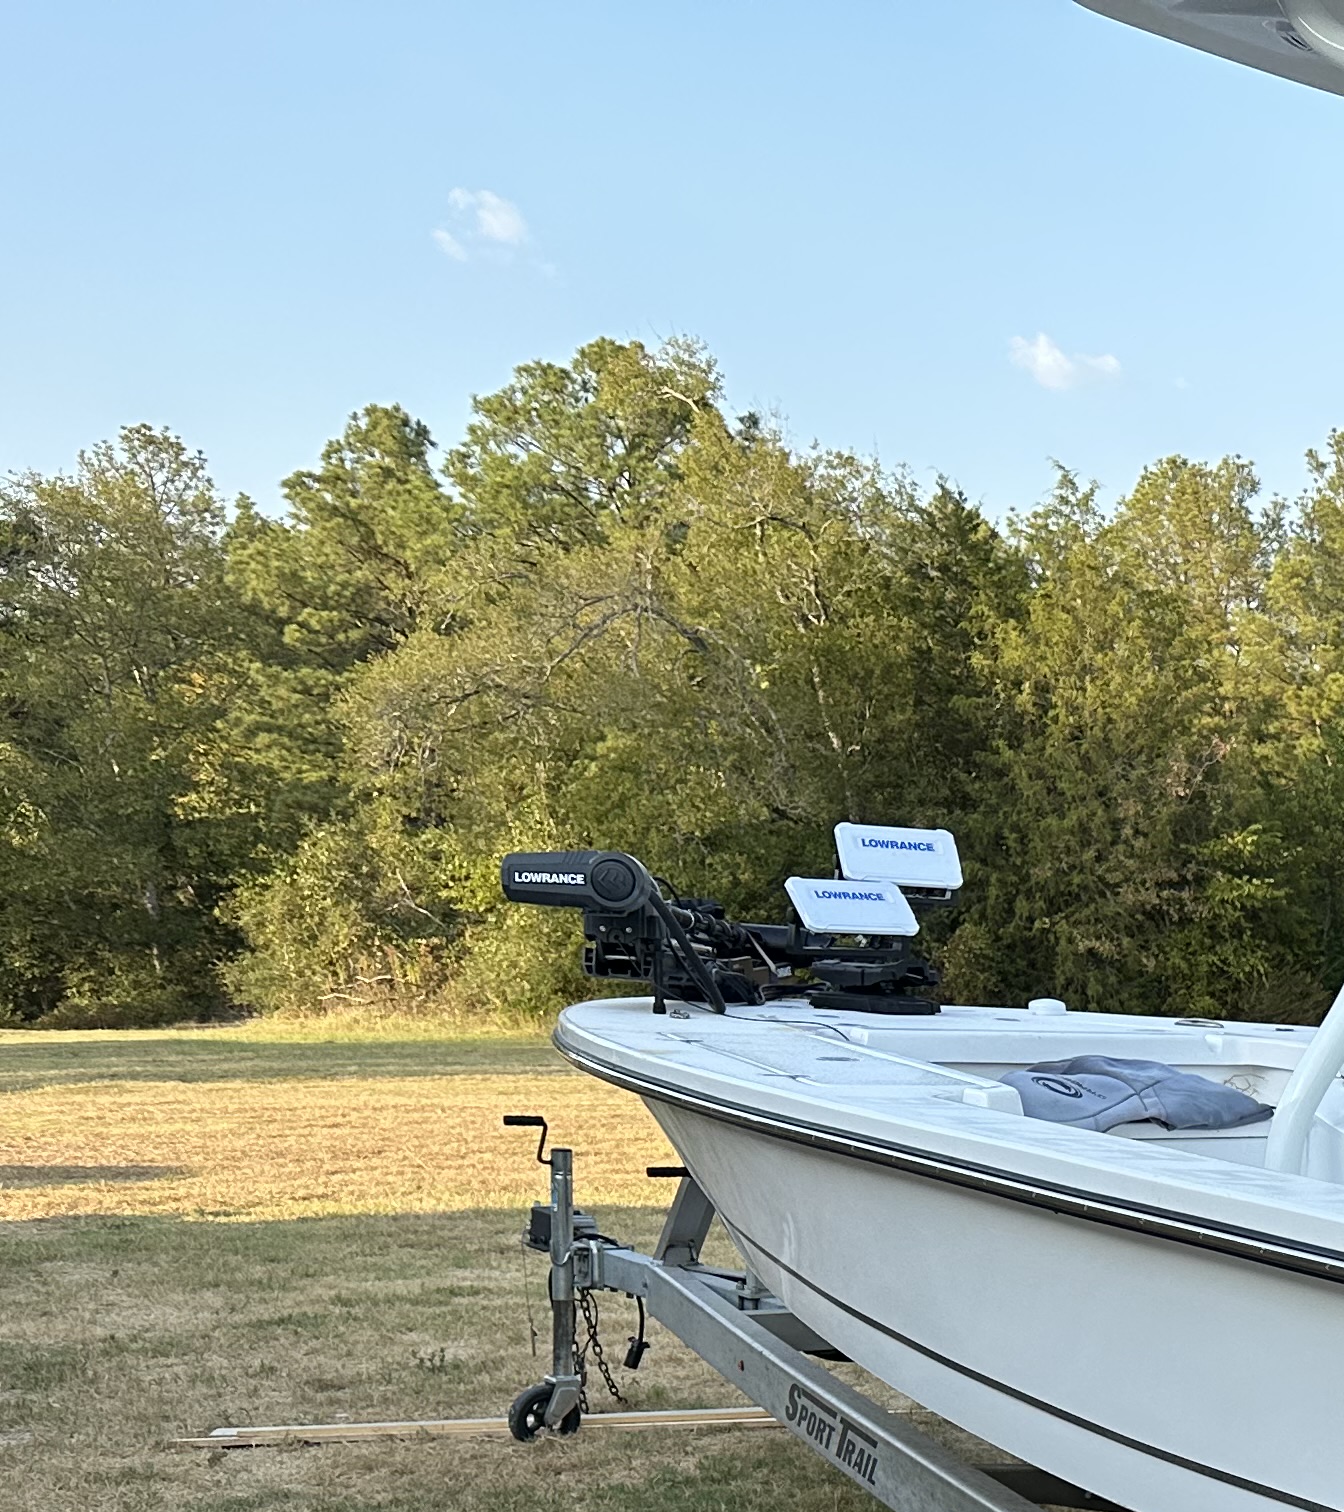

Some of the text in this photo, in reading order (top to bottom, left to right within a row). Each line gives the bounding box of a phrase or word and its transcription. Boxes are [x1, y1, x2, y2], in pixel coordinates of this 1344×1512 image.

[860, 838, 935, 852] LOWRANCE
[514, 871, 586, 885] LOWRANCE
[814, 890, 885, 901] LOWRANCE
[785, 1383, 879, 1486] SPORT TRAIL
